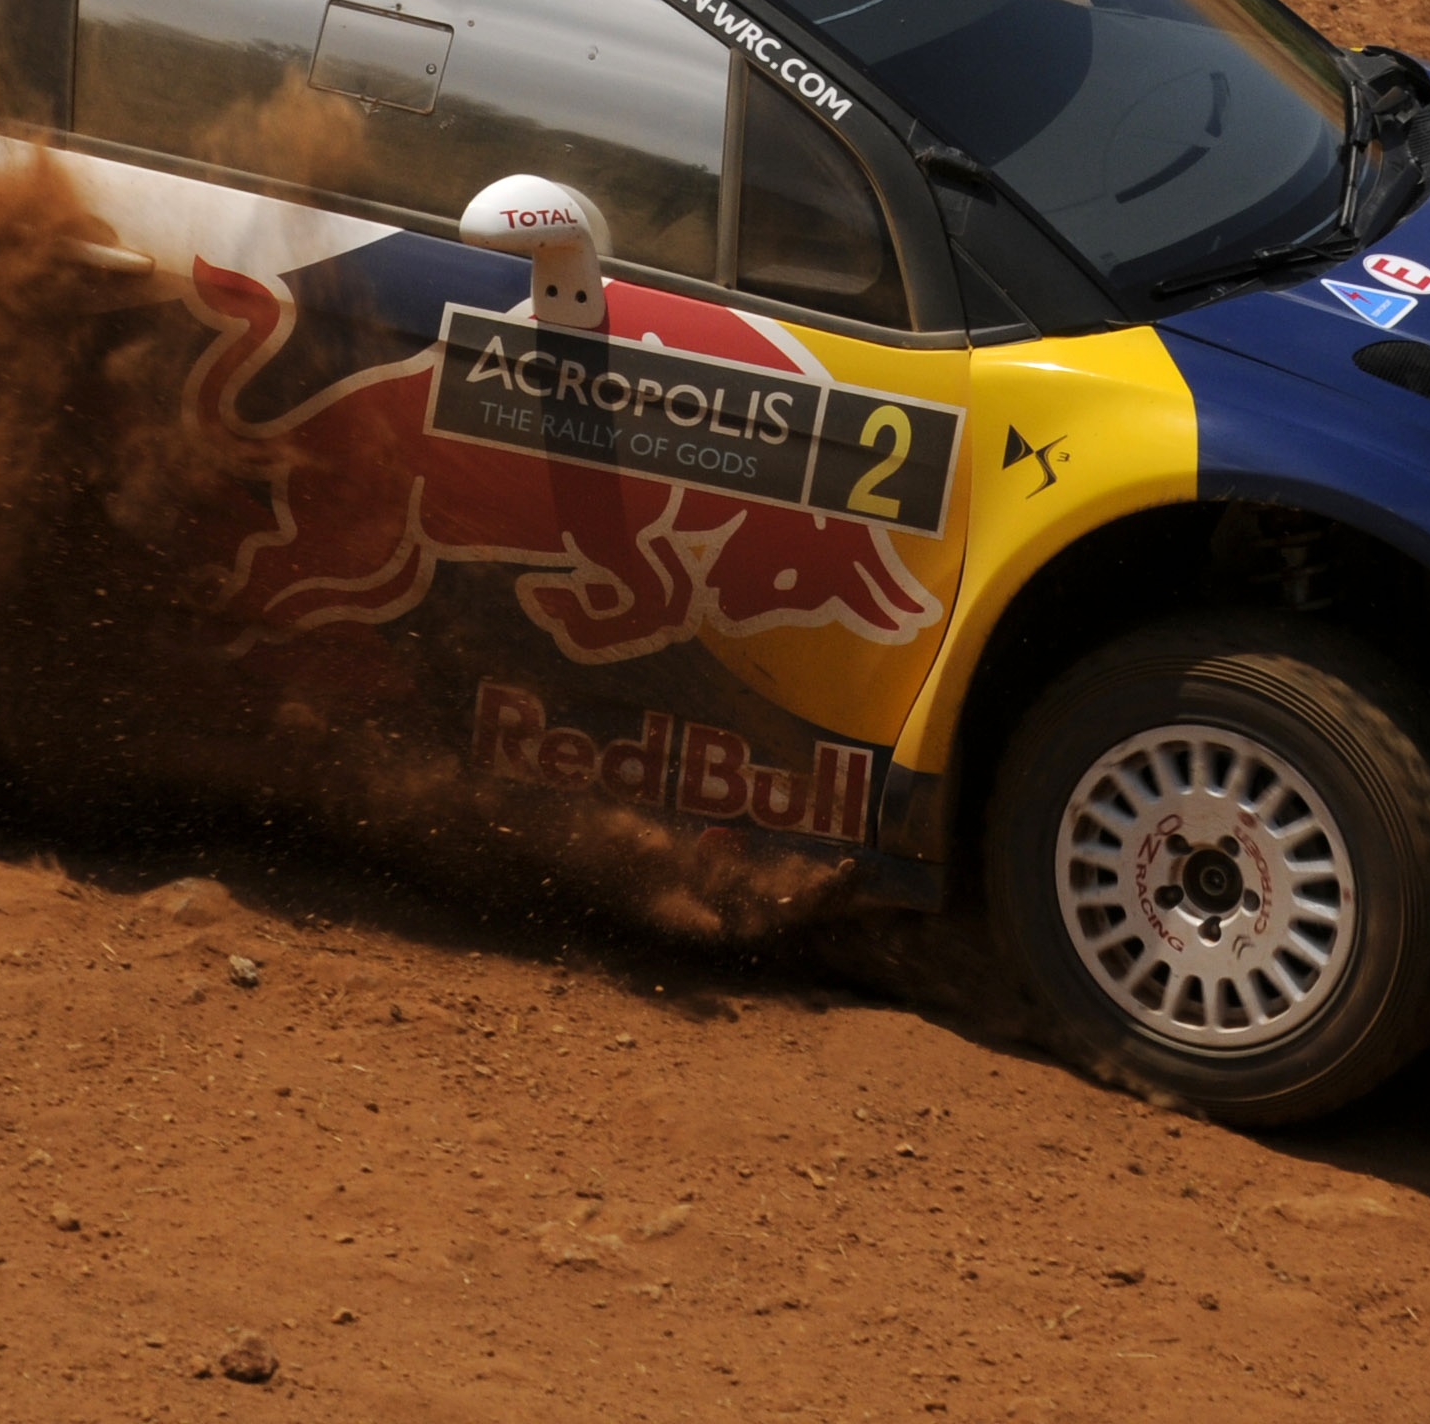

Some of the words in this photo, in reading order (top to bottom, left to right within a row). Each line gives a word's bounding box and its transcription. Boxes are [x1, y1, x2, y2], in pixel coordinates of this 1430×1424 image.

[500, 207, 579, 230] TOTAL
[465, 335, 794, 446] ACROPOLIS
[846, 404, 912, 520] 2
[479, 401, 532, 432] THE
[540, 415, 622, 450] RALLY
[630, 432, 670, 460] OF
[676, 442, 758, 479] GODS
[476, 682, 671, 804] Red
[676, 721, 873, 844] Bull
[1135, 864, 1185, 953] RACING
